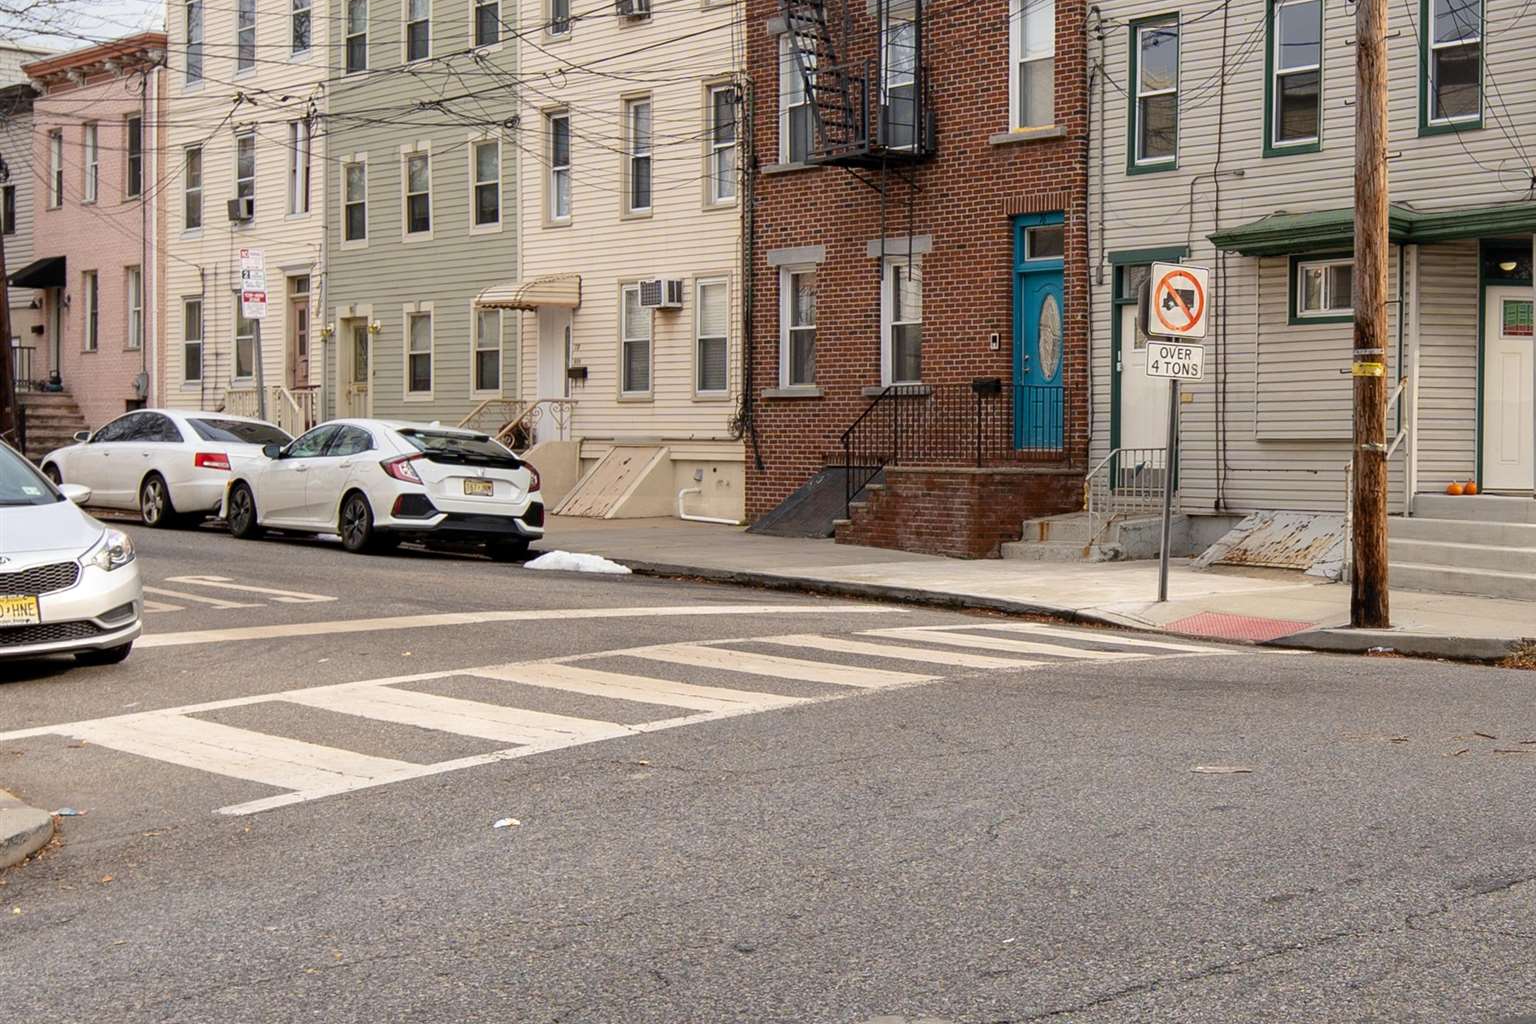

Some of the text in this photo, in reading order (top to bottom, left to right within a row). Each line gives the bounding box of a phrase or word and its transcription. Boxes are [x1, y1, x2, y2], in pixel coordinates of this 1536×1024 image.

[1160, 347, 1191, 360] OVER
[1152, 360, 1198, 376] 4 TONS
